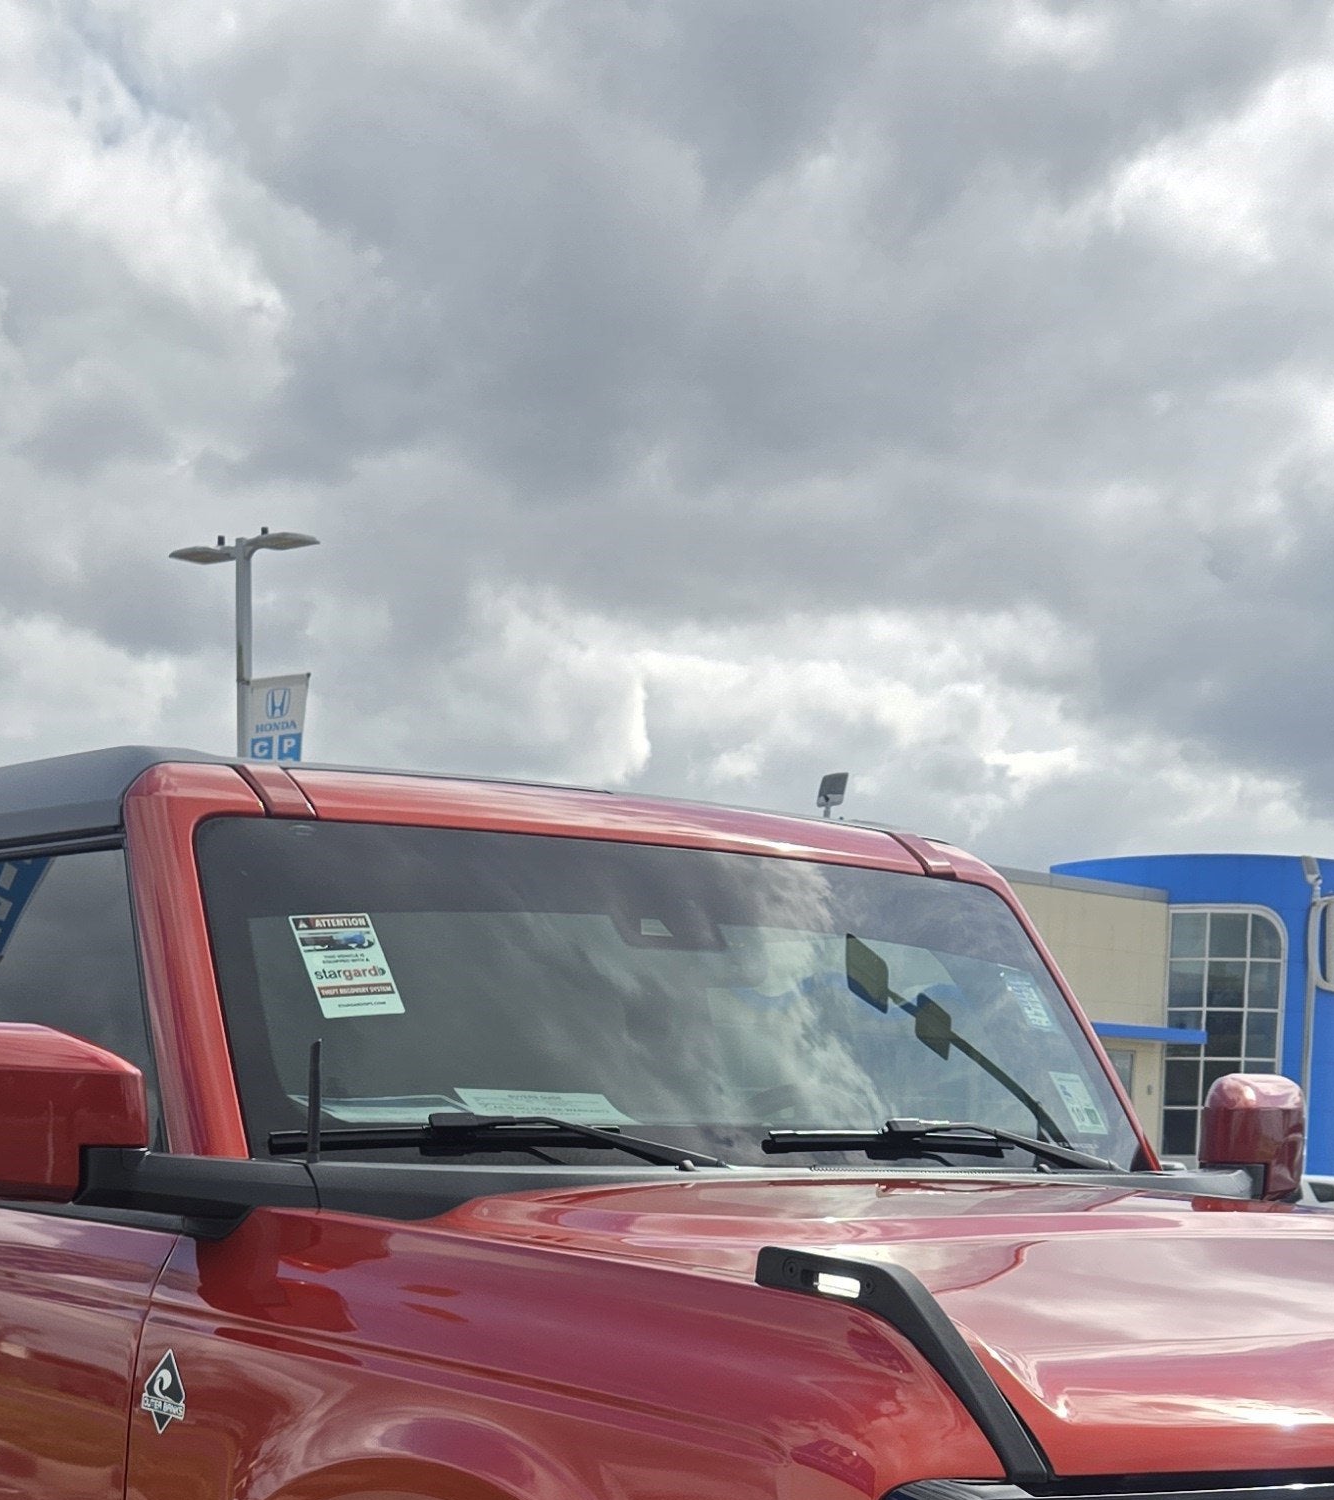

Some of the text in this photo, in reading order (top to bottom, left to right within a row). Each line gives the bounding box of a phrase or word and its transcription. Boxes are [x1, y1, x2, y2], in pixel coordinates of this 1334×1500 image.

[255, 720, 298, 734] HONDA
[314, 917, 367, 928] ATTENTION
[163, 1401, 184, 1418] BANKS
